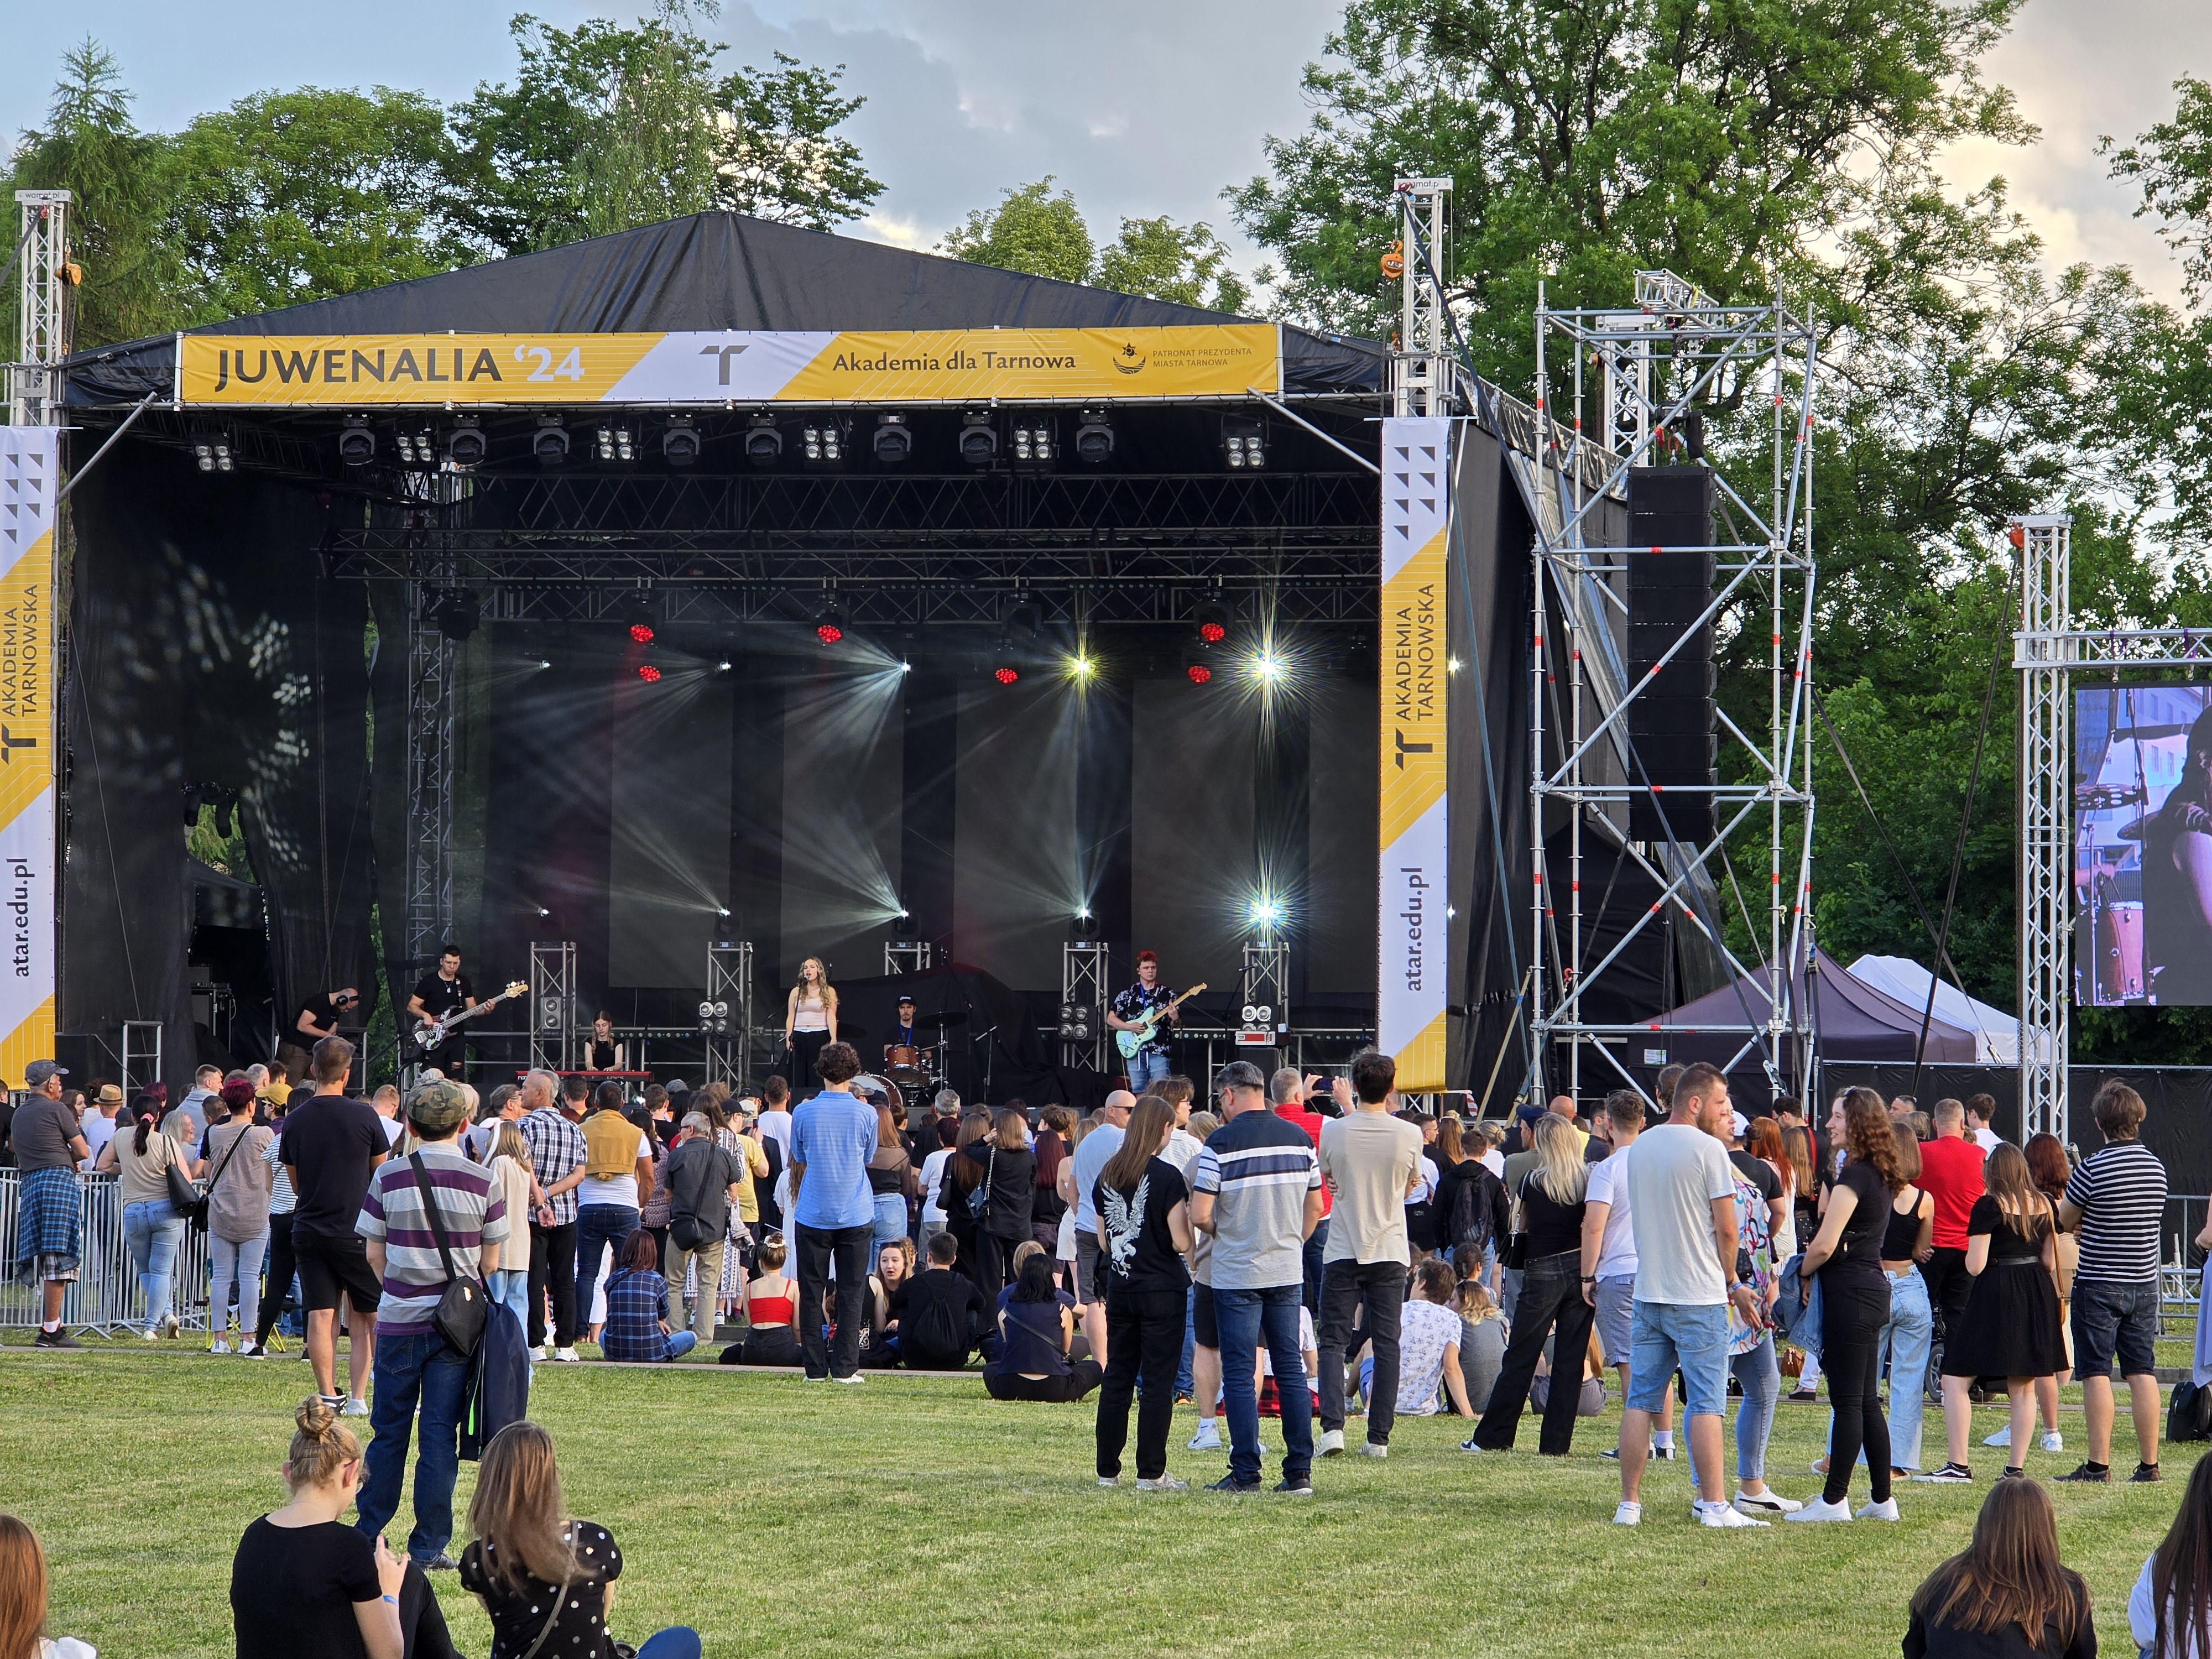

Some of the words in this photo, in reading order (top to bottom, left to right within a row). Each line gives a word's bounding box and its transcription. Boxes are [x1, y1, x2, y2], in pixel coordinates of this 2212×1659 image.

[215, 348, 502, 392] JUWENALIA
[833, 352, 940, 371] Akademia
[946, 351, 978, 371] dla
[982, 351, 1076, 371] Tarnowa
[1, 607, 18, 717] AKADEMIA
[22, 583, 38, 717] TARNOWSKA
[1395, 607, 1412, 721] AKADEMIA
[1417, 583, 1434, 721] TARNOWSKA
[6, 858, 35, 977] atar.edu.pl
[1400, 868, 1430, 991] atar.edu.pl
